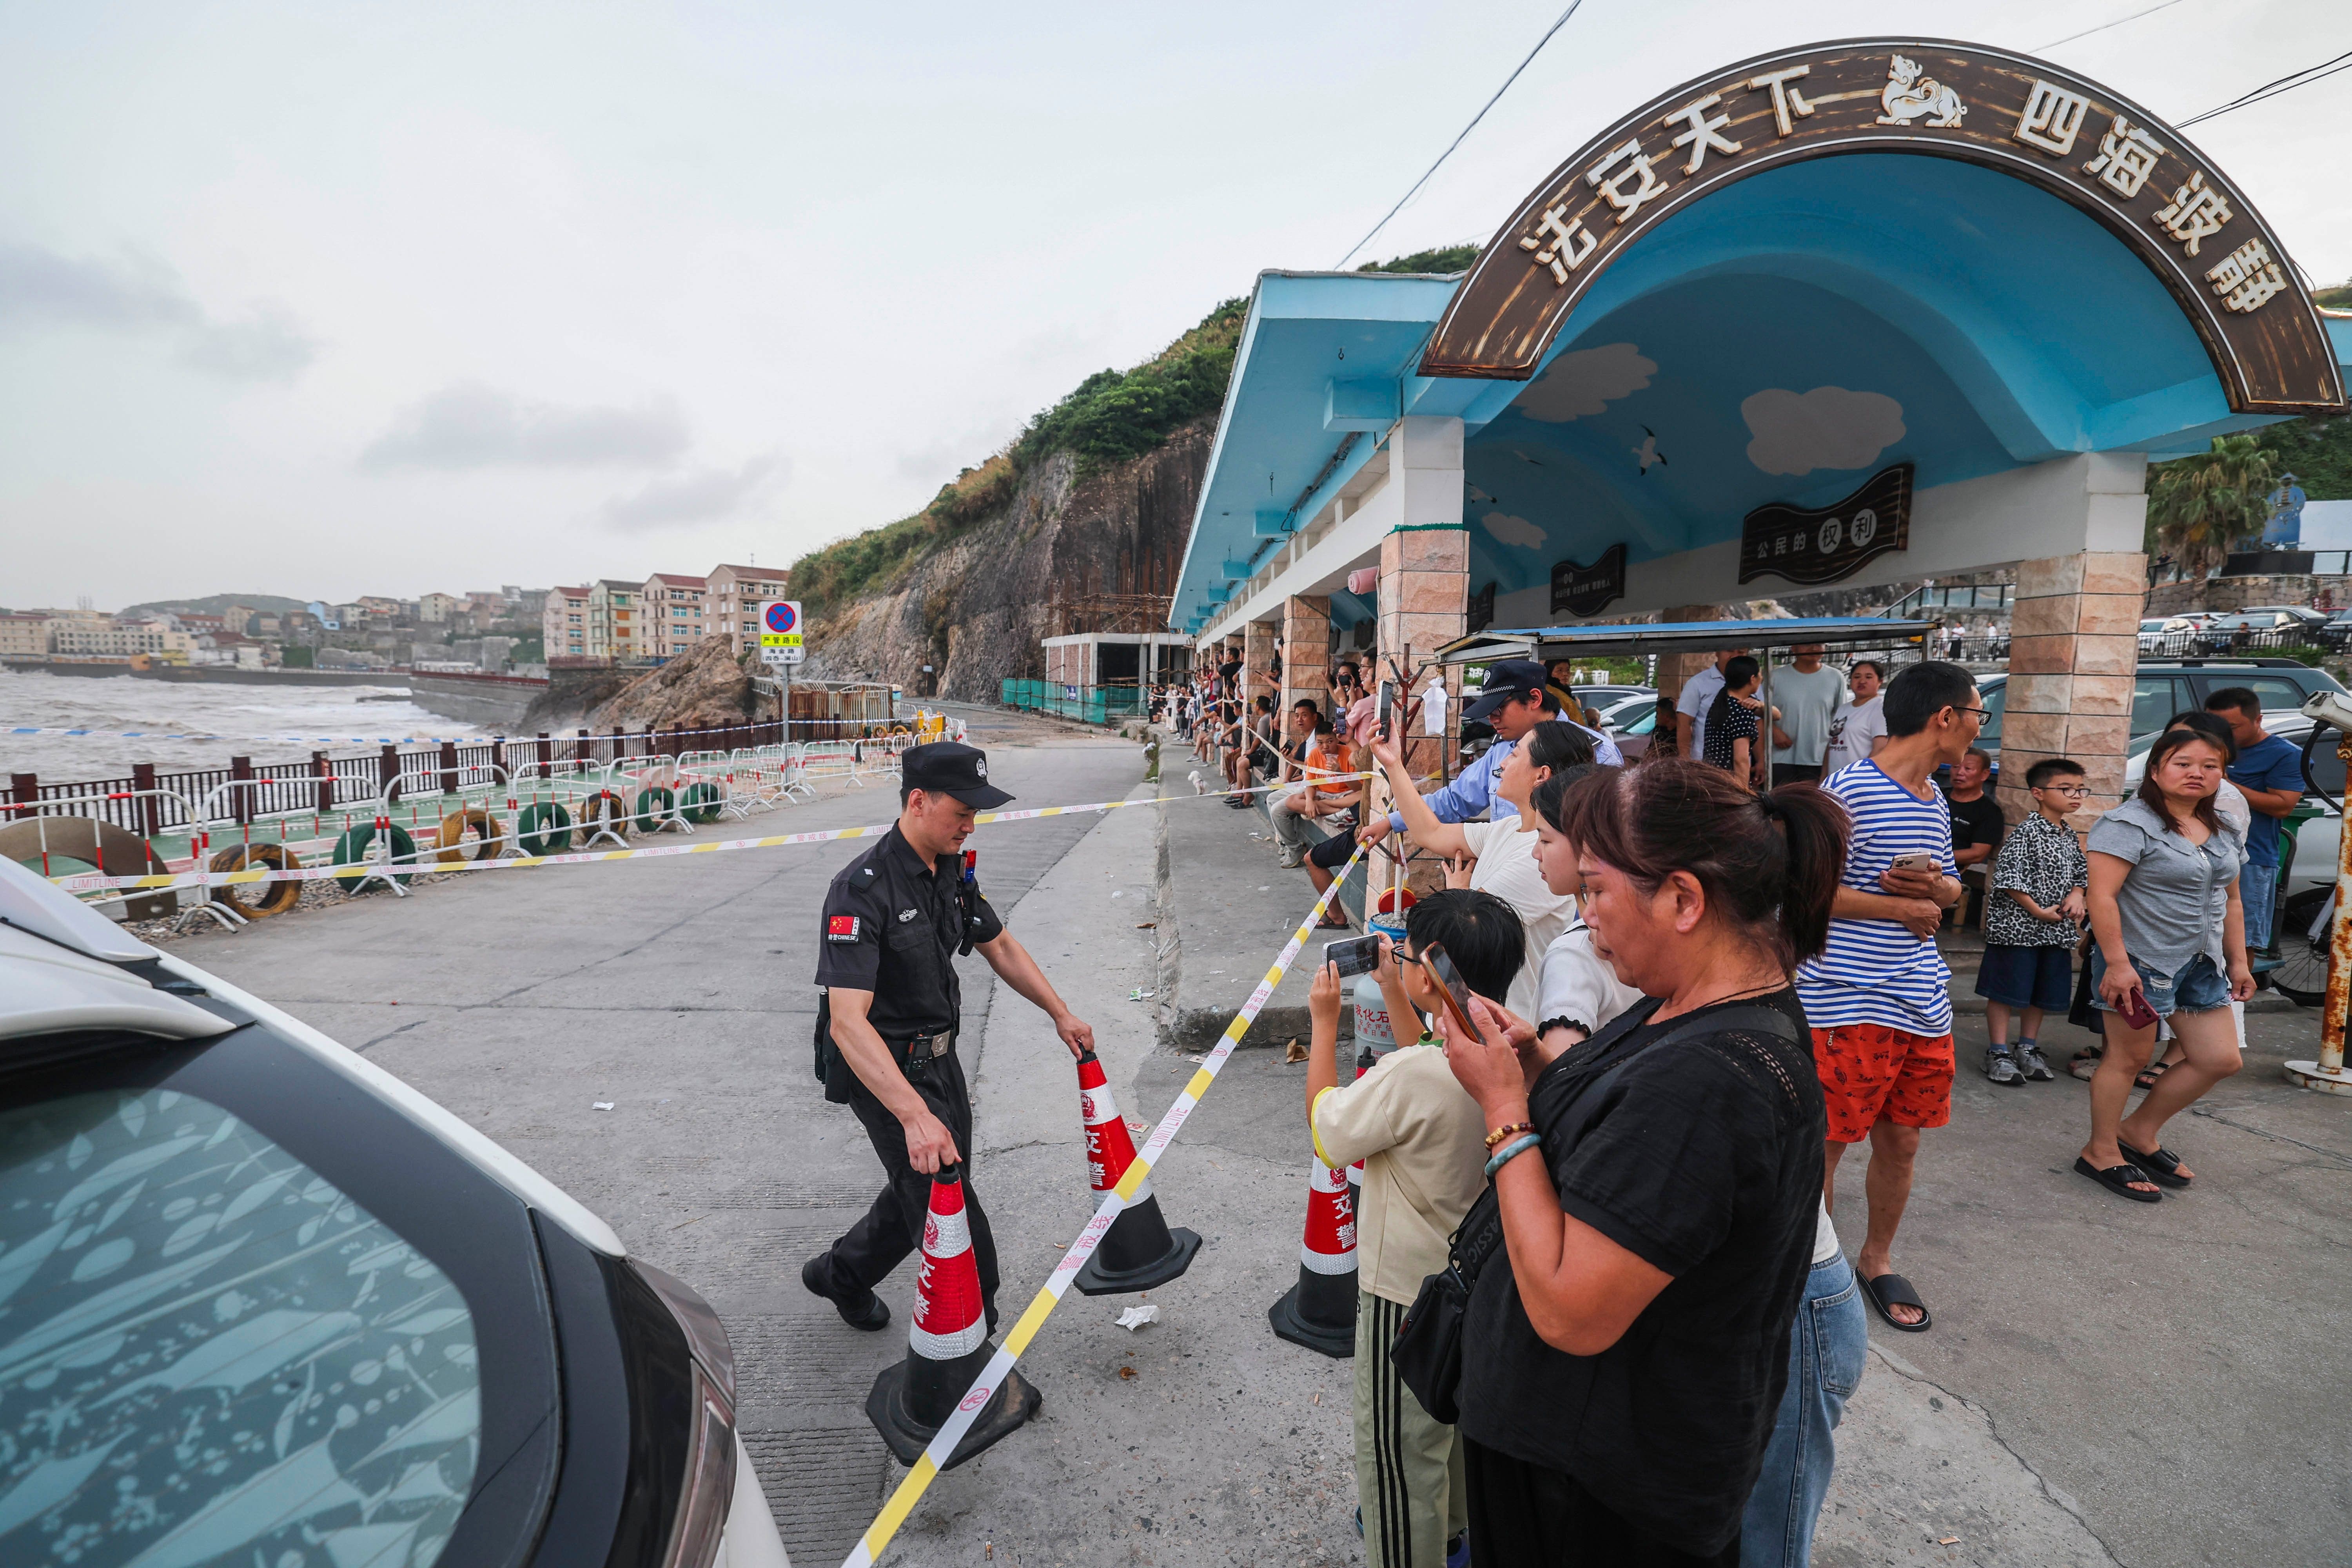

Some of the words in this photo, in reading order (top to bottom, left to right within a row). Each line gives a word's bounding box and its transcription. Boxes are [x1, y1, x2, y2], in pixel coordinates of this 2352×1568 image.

[1519, 63, 1816, 287] 法安天下
[2012, 78, 2288, 316] 四海波静
[1757, 514, 1873, 559] 公民的权利
[1069, 804, 1096, 813] LIMITLINE
[1004, 810, 1031, 820] 警戒线
[796, 832, 828, 842] 警戒线
[644, 846, 680, 857] LIMITLINE
[555, 853, 592, 863] 警戒线
[277, 870, 319, 880] 警戒线
[379, 864, 421, 875] LIMITLINE
[72, 878, 121, 889] LIMITLINE
[1144, 1107, 1188, 1149] LIMITLINE
[1332, 1192, 1356, 1249] 交警
[1056, 1215, 1115, 1272] 警戒线
